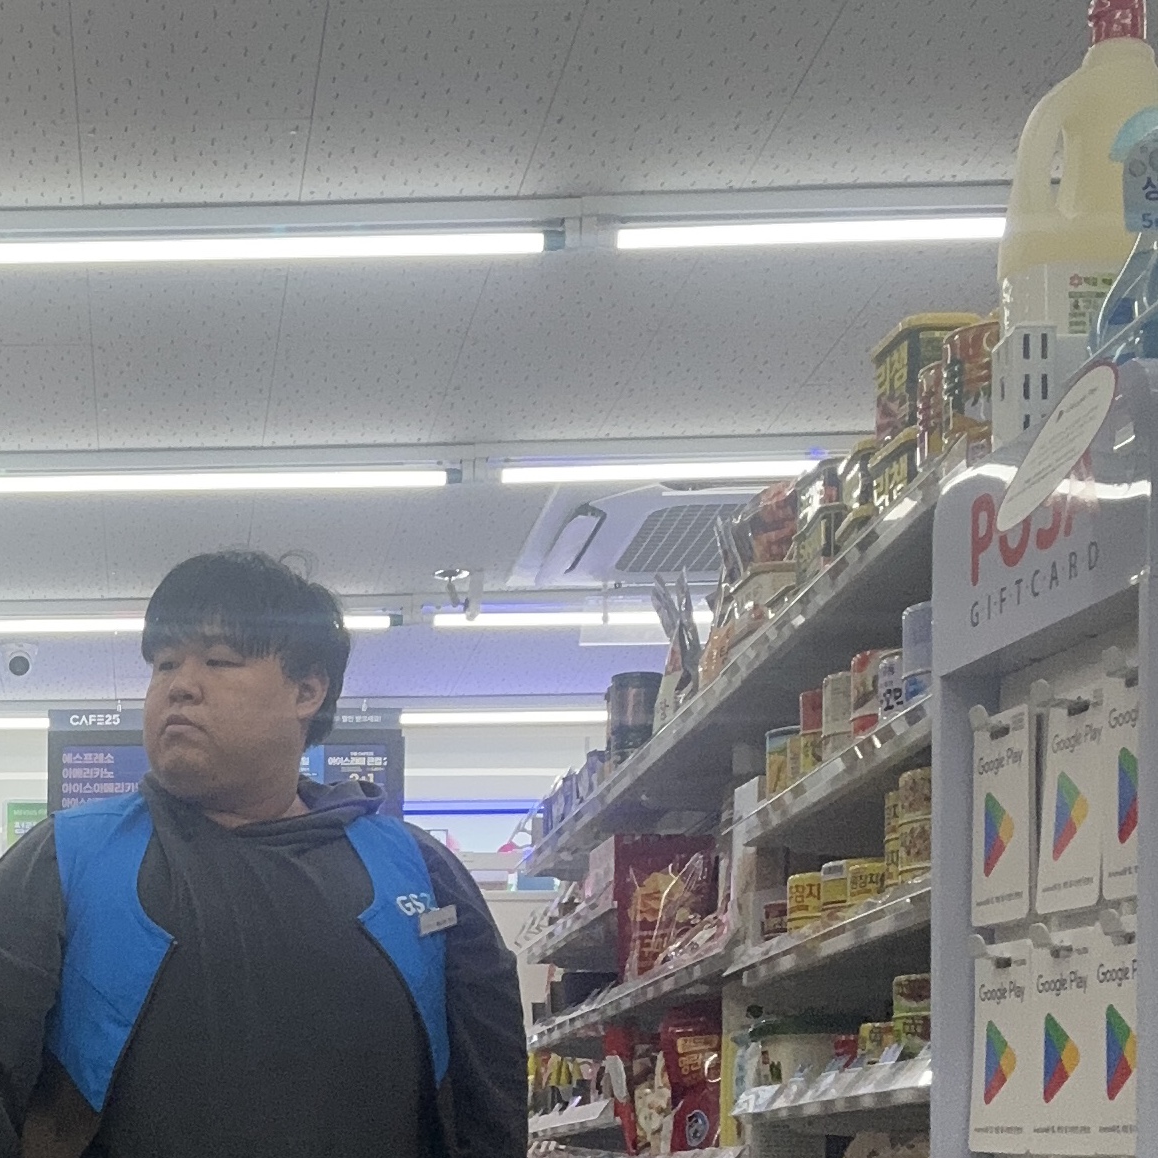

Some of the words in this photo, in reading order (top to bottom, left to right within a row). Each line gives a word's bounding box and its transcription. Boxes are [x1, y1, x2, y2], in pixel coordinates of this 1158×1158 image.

[69, 714, 121, 726] CAFE25
[1108, 707, 1137, 729] Goog
[1051, 732, 1083, 754] Google
[1083, 724, 1103, 745] Play
[62, 753, 115, 764] 에스프레소
[977, 756, 1011, 776] Google
[1007, 747, 1023, 768] Play
[62, 768, 115, 779] 아메리카노
[62, 782, 139, 793] 아이스아메리카
[396, 892, 440, 917] GS2
[1036, 974, 1068, 997] Google
[1069, 970, 1088, 994] Play
[1097, 962, 1130, 987] Google
[979, 983, 1008, 1005] Google
[1009, 980, 1026, 1003] Play
